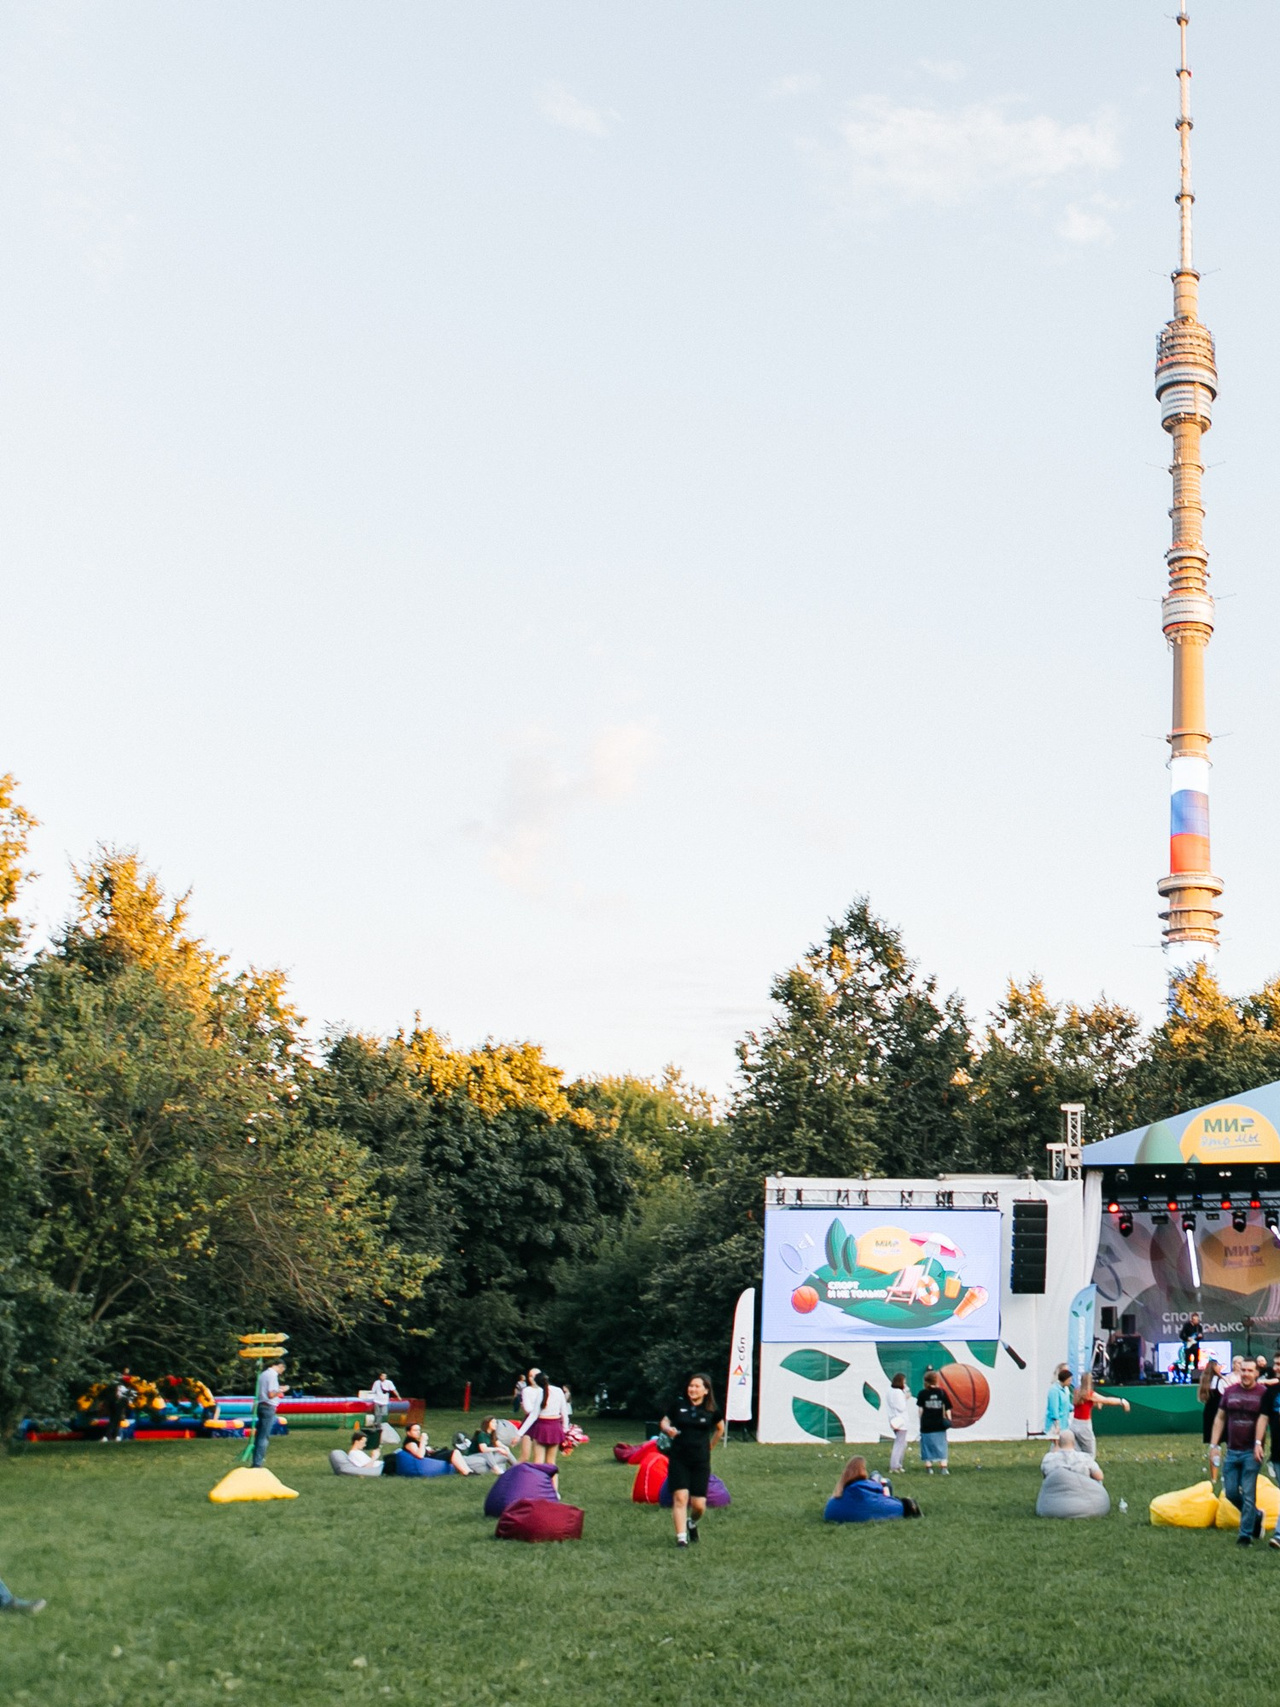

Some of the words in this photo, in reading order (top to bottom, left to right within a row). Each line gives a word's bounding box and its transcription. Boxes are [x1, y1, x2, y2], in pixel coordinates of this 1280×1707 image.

[1204, 1118, 1254, 1132] МИР
[1223, 1245, 1260, 1256] МИР
[1162, 1325, 1172, 1334] И
